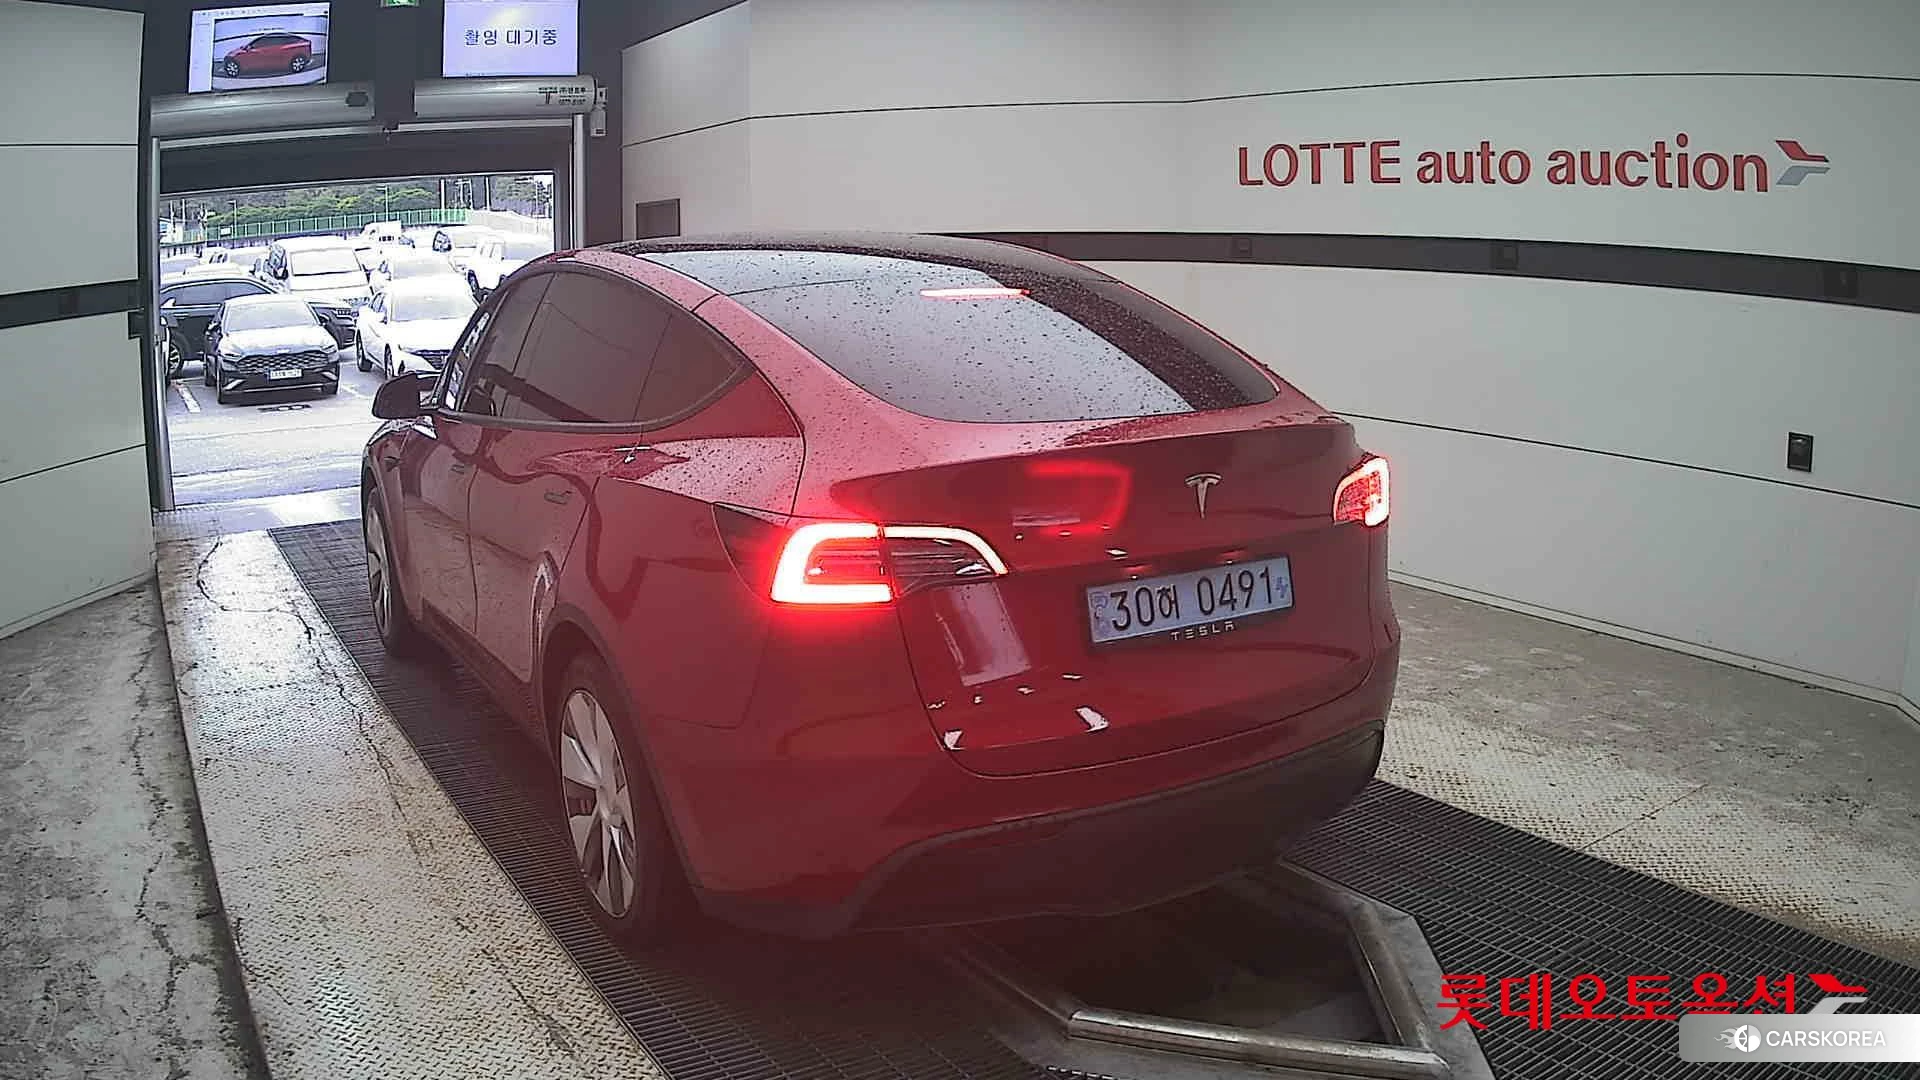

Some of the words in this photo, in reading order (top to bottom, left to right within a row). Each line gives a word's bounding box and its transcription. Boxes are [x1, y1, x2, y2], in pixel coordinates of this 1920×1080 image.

[464, 28, 498, 46] 촬영
[506, 28, 558, 46] 대기중
[1239, 140, 1400, 186] LOTTE
[1416, 140, 1531, 185] auto
[1546, 132, 1769, 193] auction
[1110, 584, 1180, 631] 30허
[1196, 566, 1272, 616] 0491
[1170, 621, 1235, 641] TESLA
